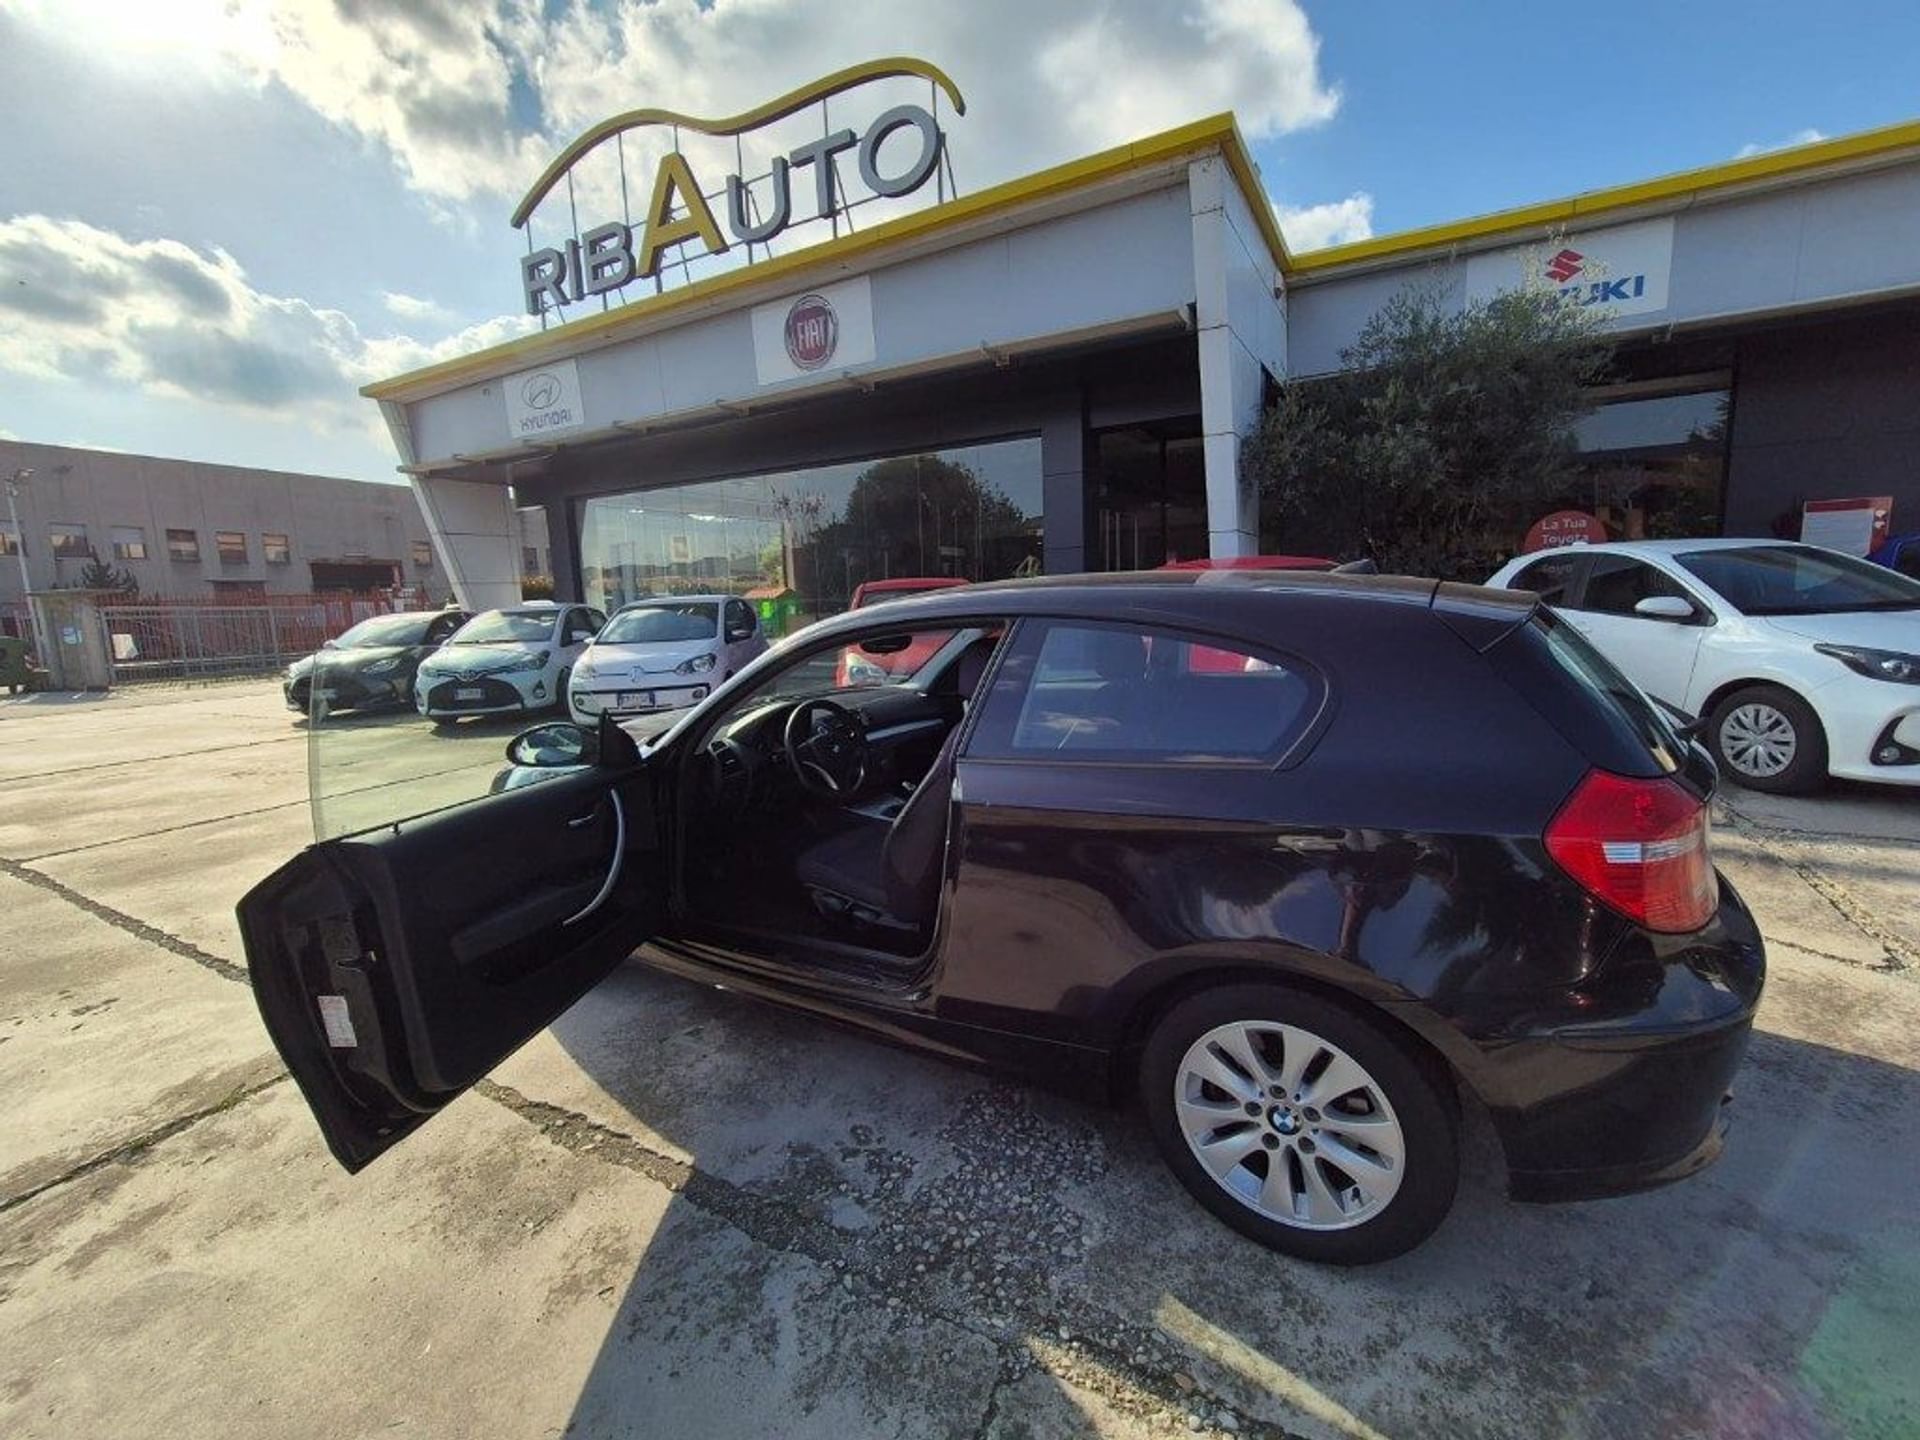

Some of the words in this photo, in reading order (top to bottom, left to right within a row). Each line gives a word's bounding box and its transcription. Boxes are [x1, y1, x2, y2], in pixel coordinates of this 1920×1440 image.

[521, 105, 942, 316] RIBAUTO
[796, 316, 826, 350] FIAT
[520, 408, 572, 432] HYUNDAI
